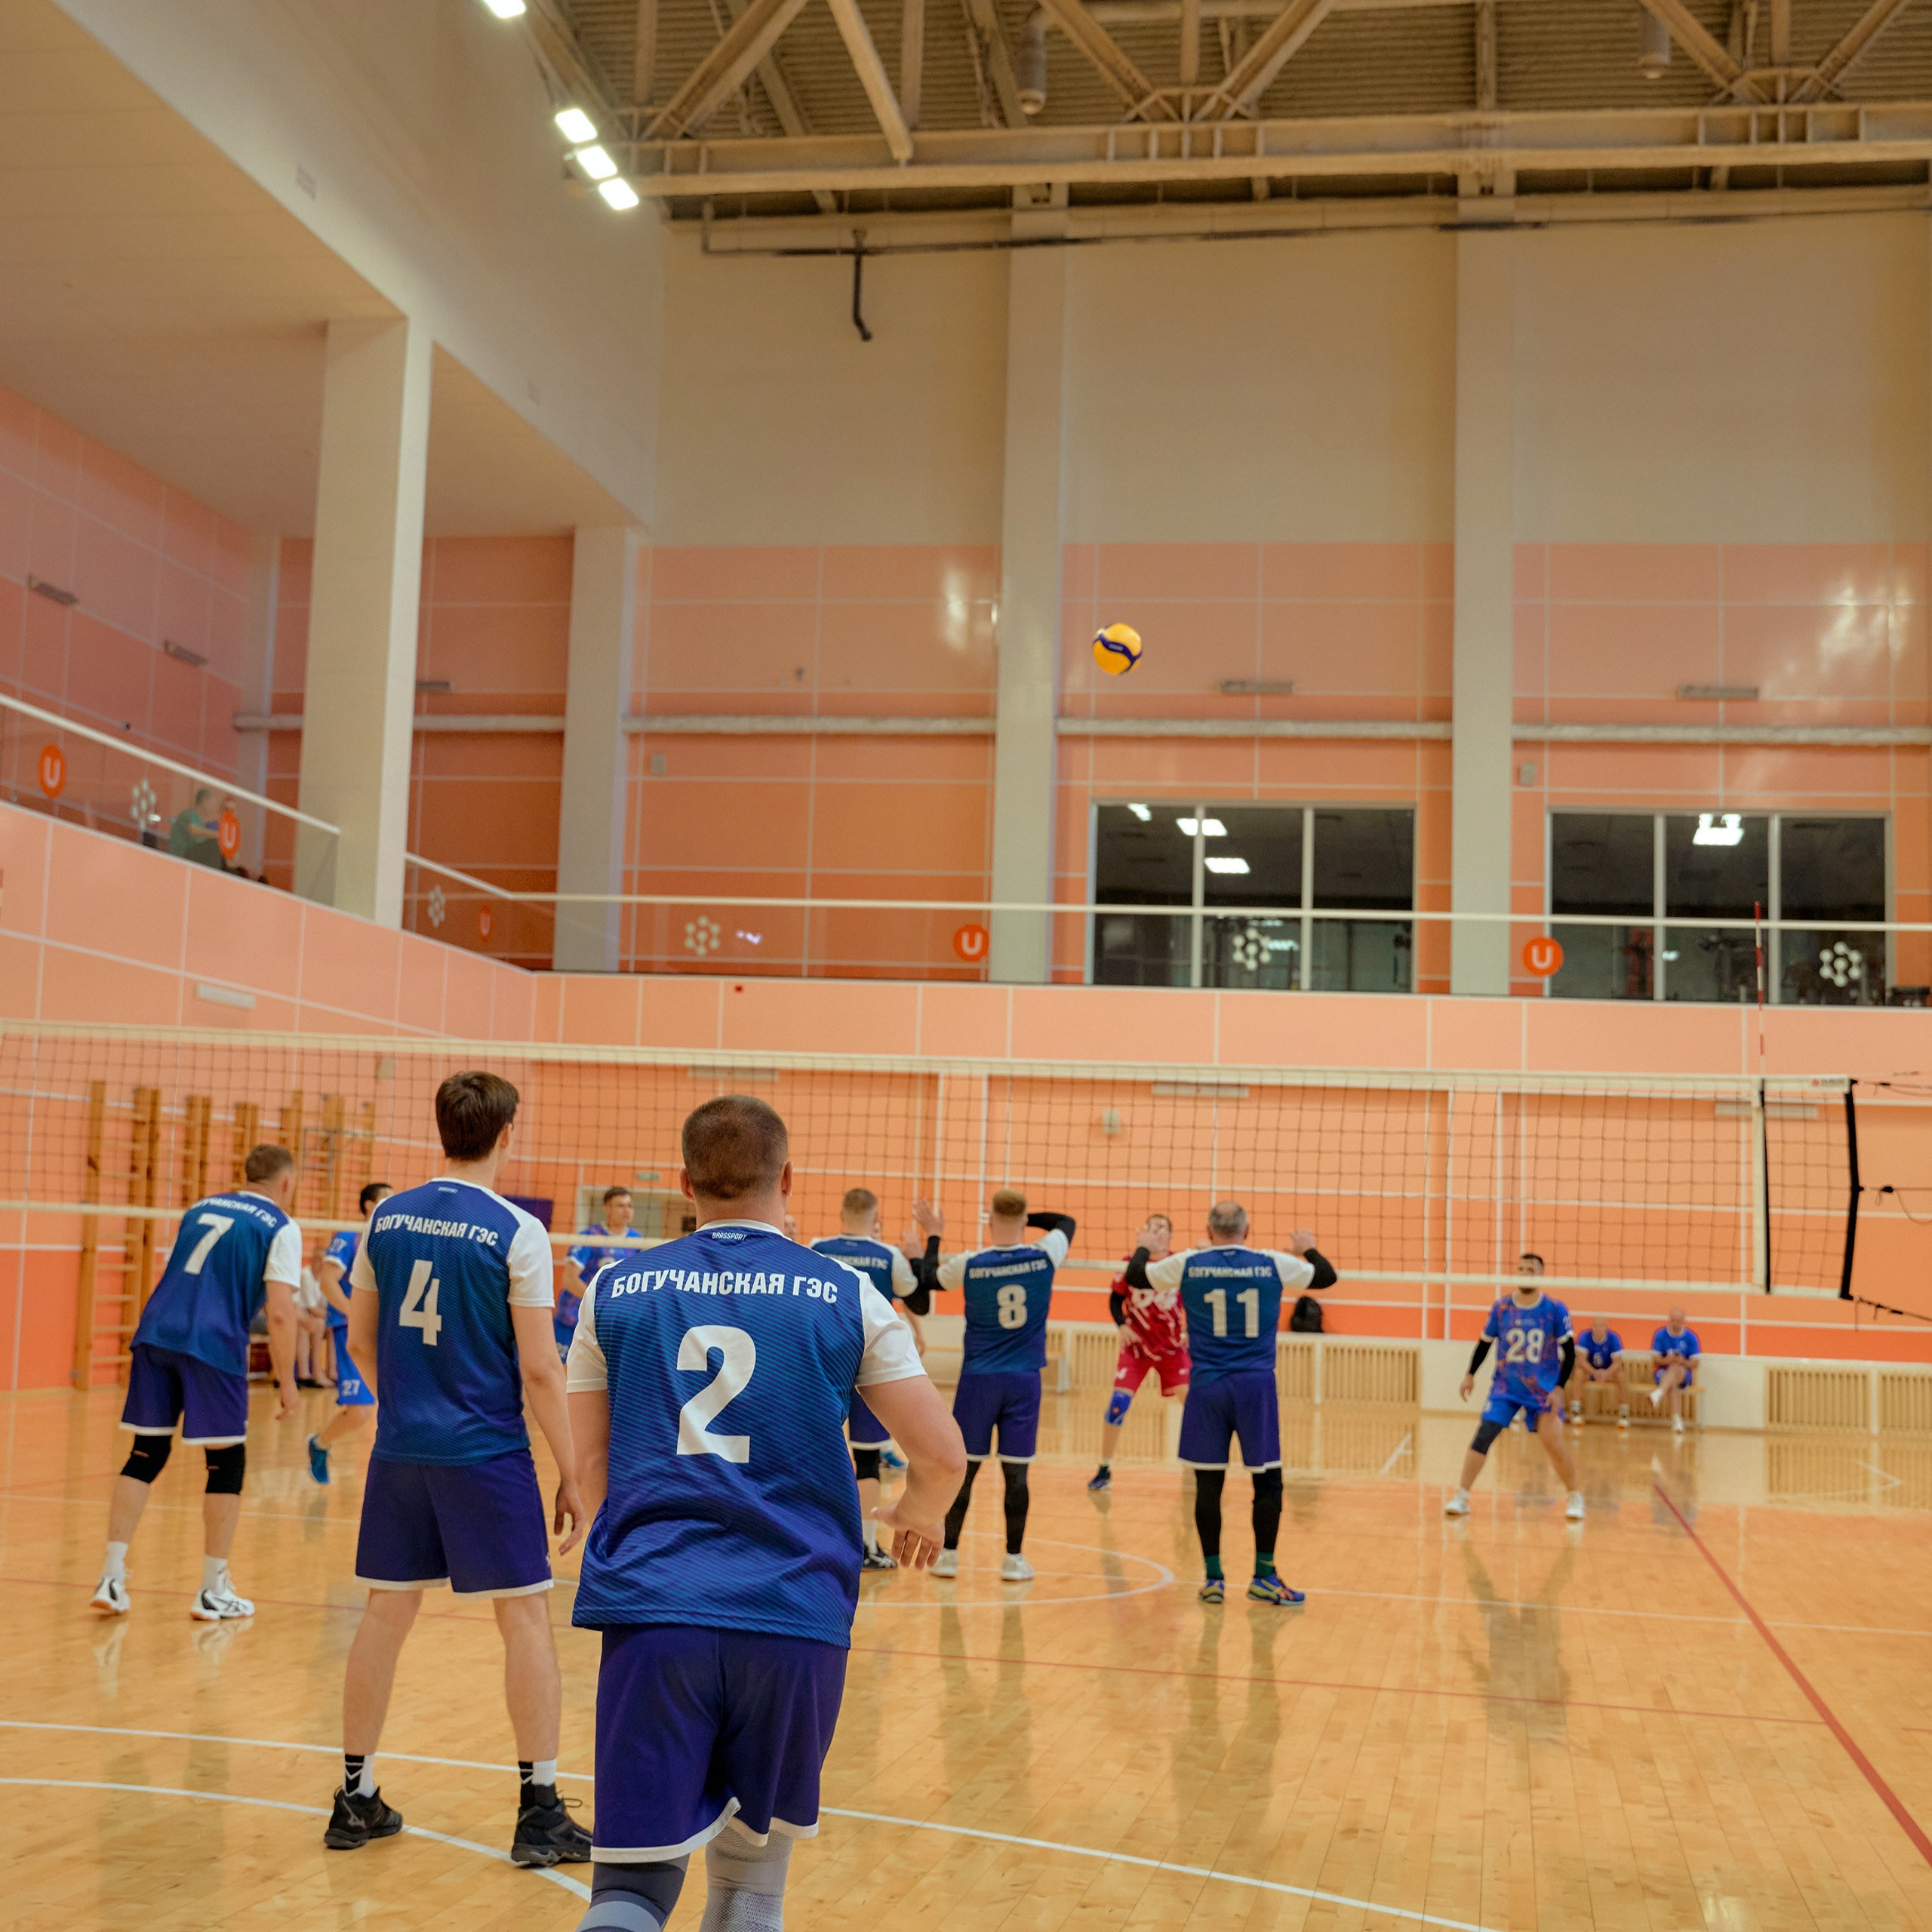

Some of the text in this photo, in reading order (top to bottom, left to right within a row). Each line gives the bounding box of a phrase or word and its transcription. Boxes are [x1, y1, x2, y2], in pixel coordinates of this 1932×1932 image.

[961, 931, 983, 955] U
[1531, 945, 1553, 969] U
[183, 1212, 235, 1275] 7
[374, 1214, 500, 1247] БОГУЧАНСКАЯ ГЭС
[712, 1232, 747, 1241] BARSSPORT
[398, 1258, 443, 1346] 4
[611, 1269, 839, 1304] БОГУЧАНСКАЯ ГЭС
[997, 1284, 1028, 1330] 8
[1204, 1287, 1260, 1339] 11
[1505, 1327, 1546, 1364] 28
[341, 1380, 361, 1395] 27
[676, 1324, 756, 1463] 2
